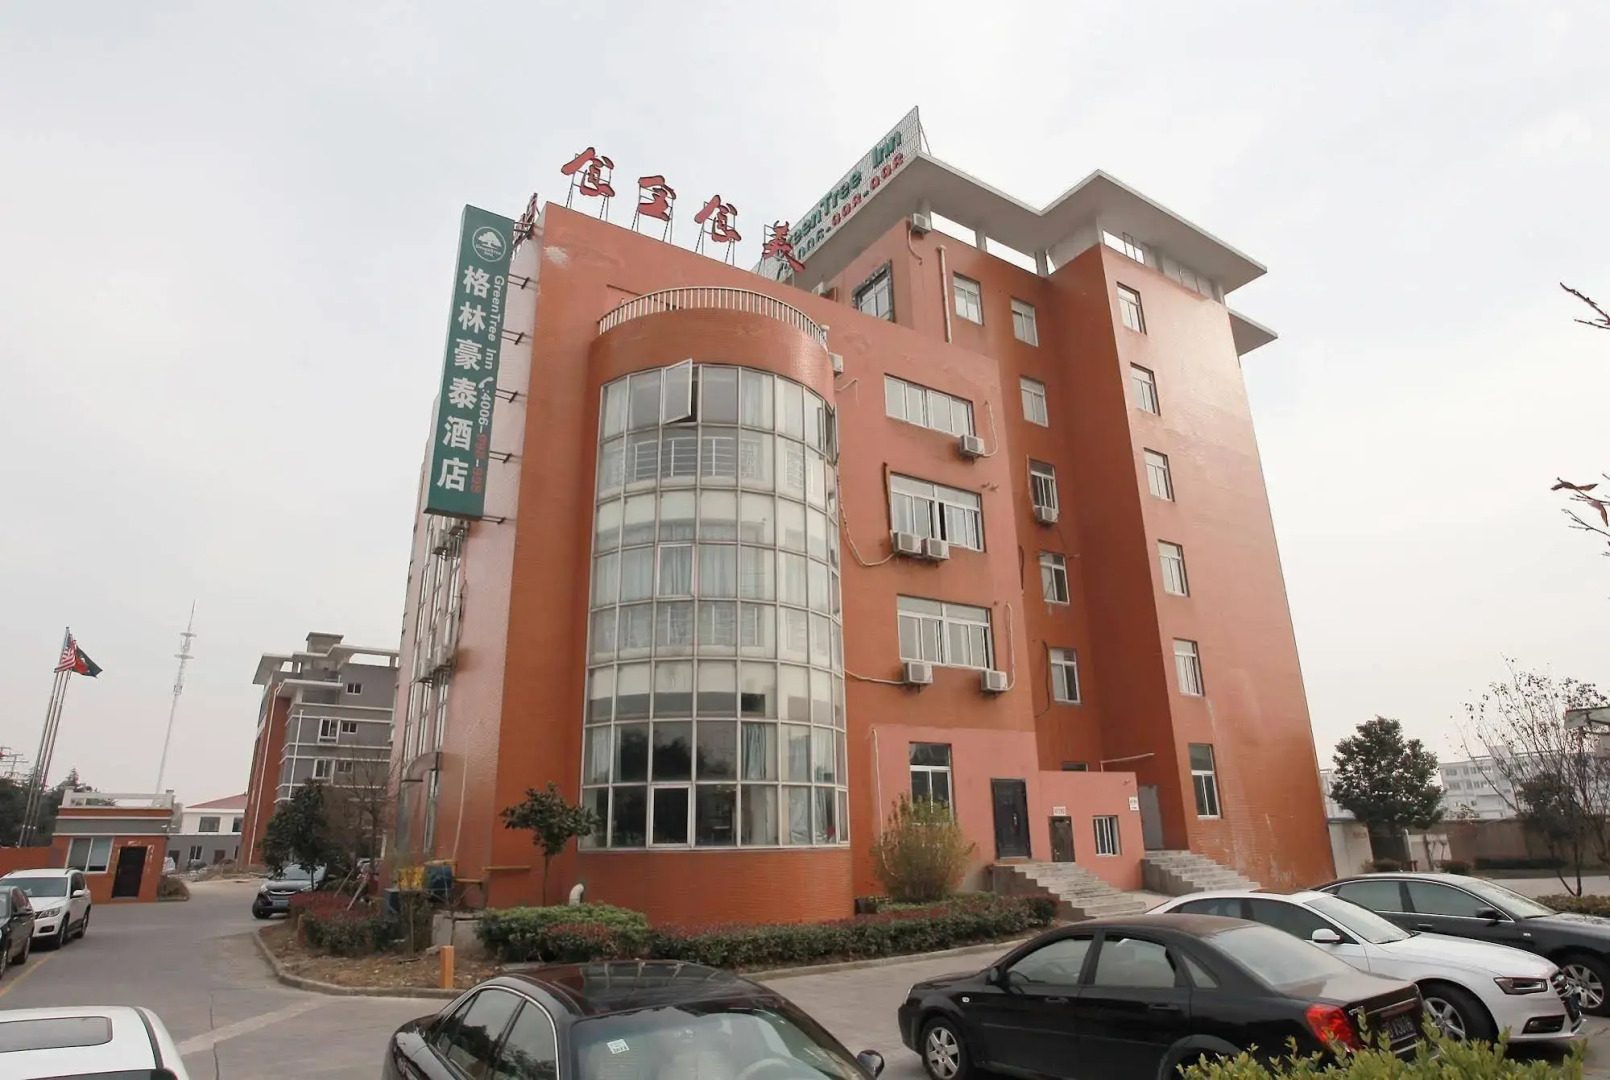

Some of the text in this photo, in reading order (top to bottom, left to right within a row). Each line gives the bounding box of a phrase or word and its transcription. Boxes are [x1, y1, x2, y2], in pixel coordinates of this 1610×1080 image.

[777, 131, 903, 258] reenTree Inn
[437, 265, 491, 492] 格林豪泰酒店
[484, 275, 505, 370] GreenTree Inn
